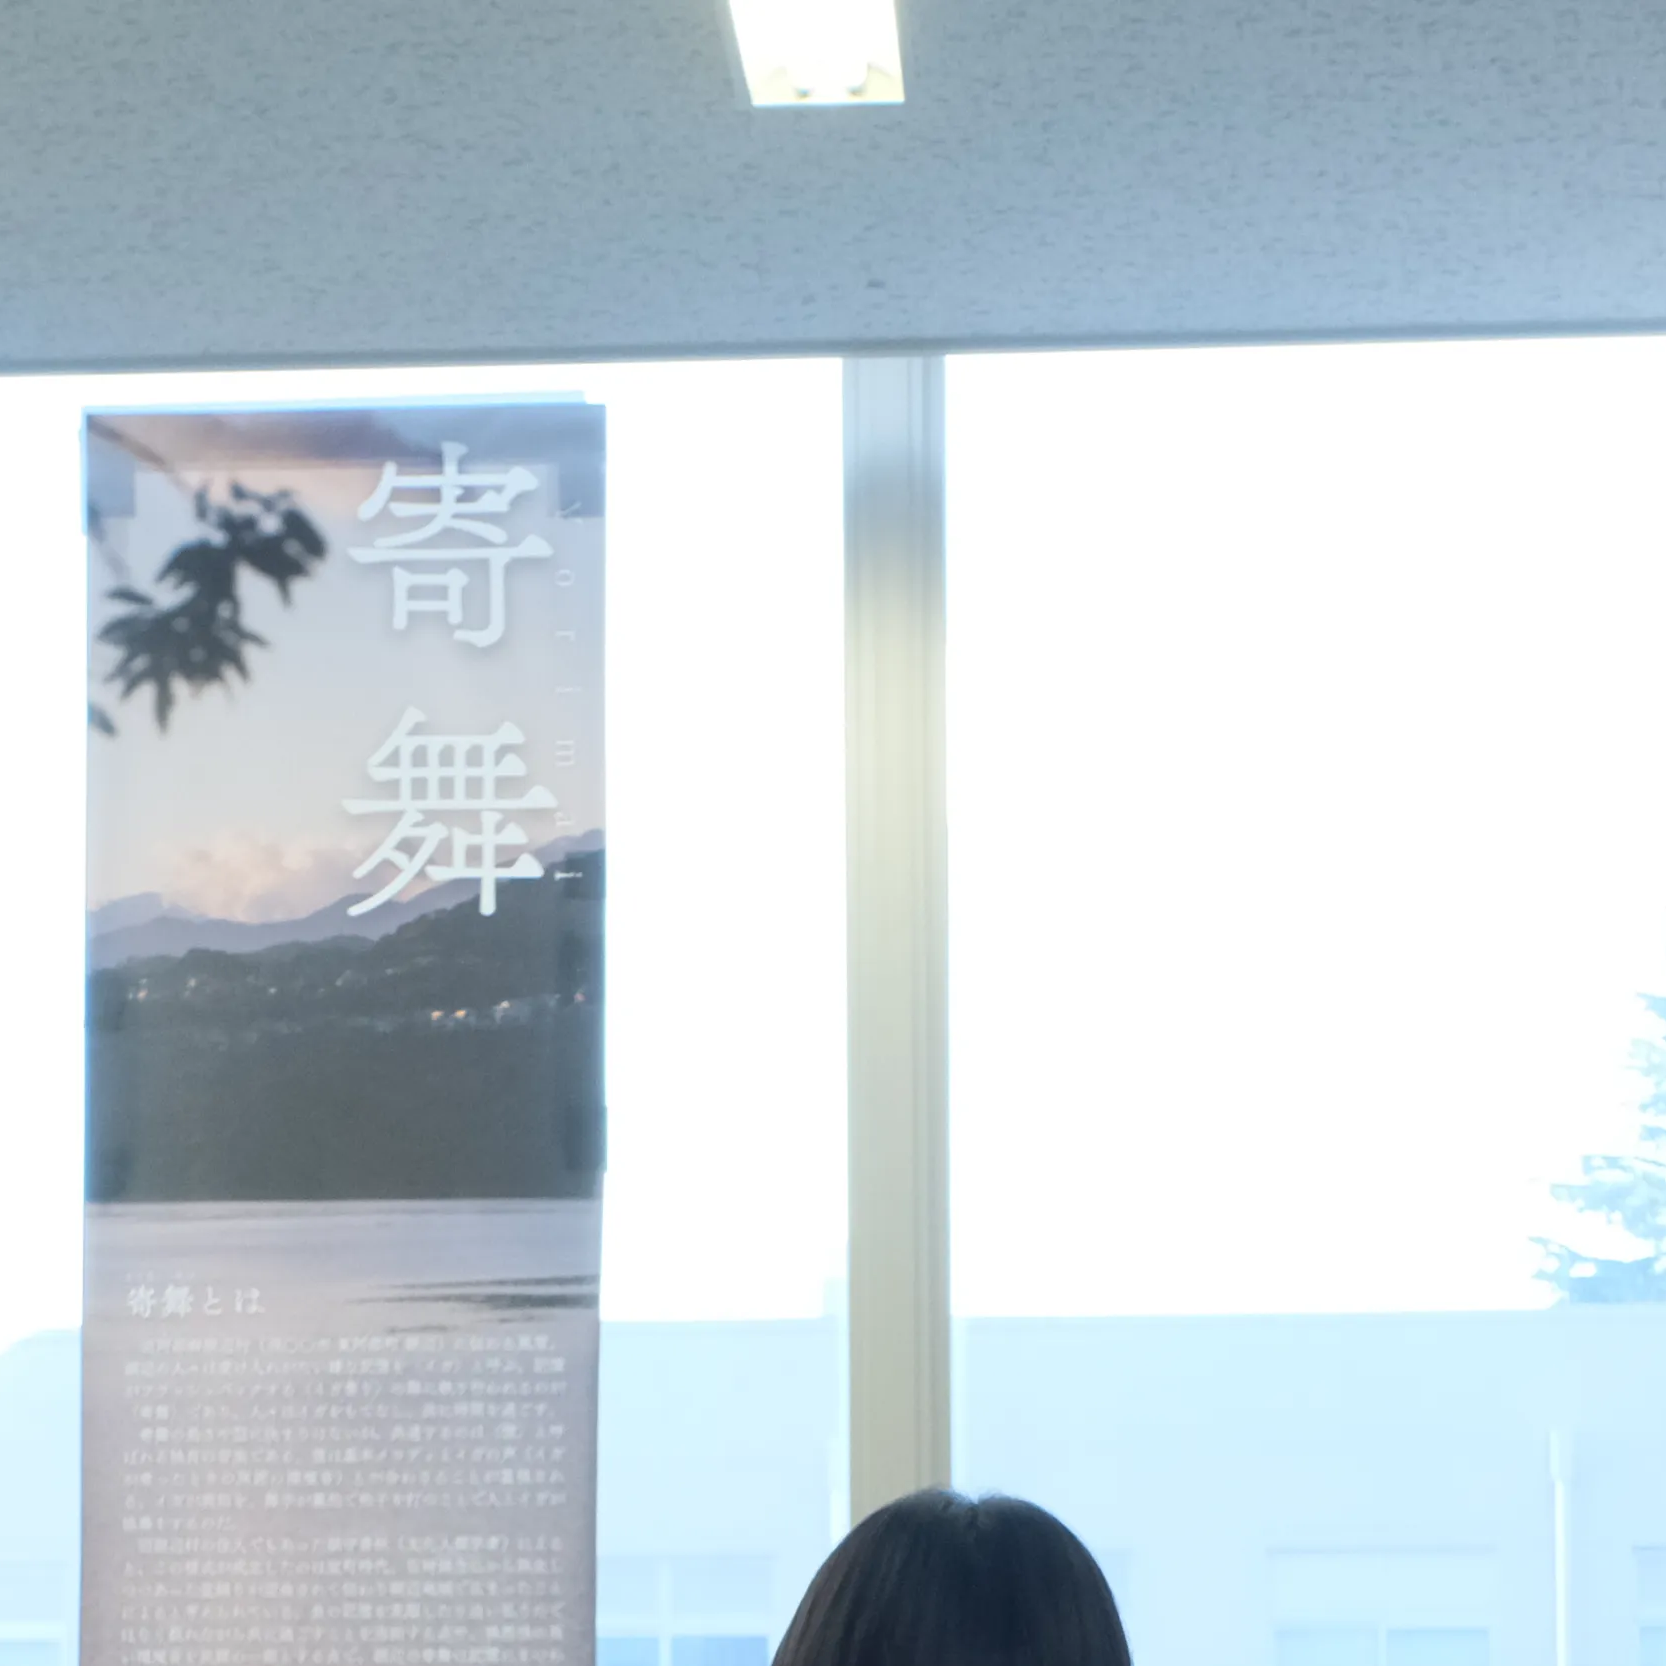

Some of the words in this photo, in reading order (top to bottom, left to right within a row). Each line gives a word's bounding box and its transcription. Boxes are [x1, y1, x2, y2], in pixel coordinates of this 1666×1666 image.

[343, 441, 558, 918] 寄舞
[126, 1283, 267, 1320] 寄舞とは
